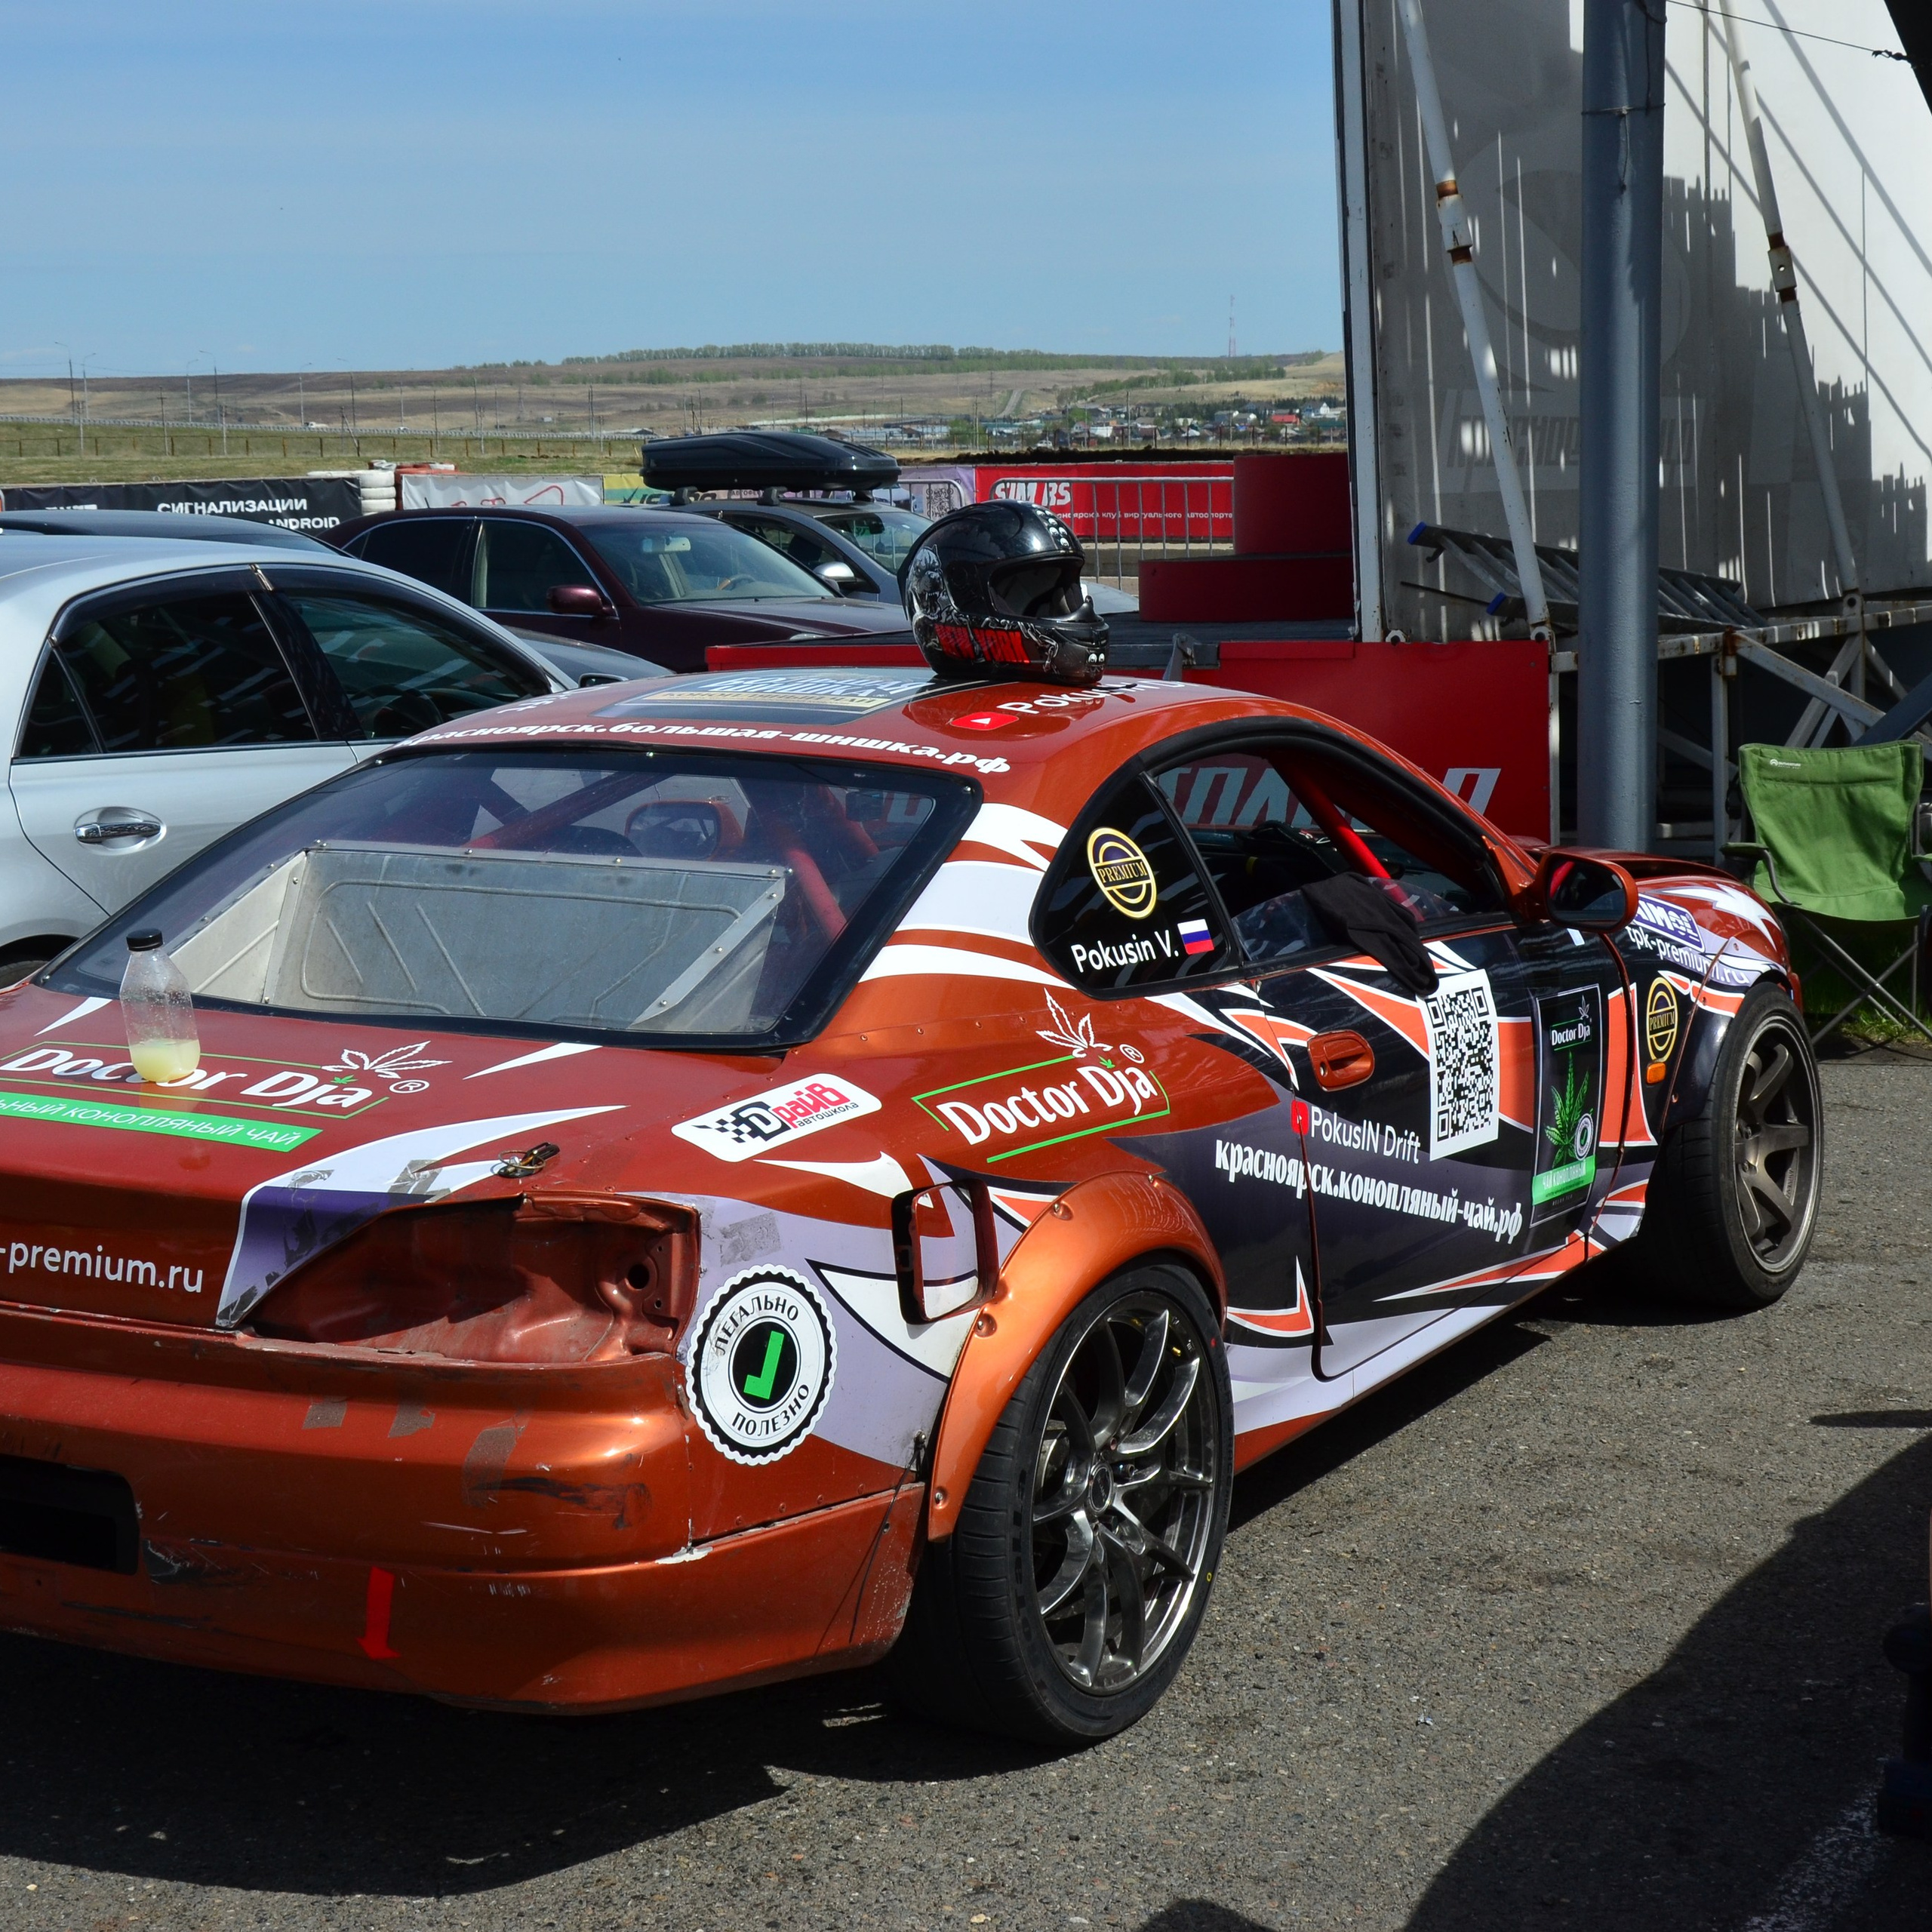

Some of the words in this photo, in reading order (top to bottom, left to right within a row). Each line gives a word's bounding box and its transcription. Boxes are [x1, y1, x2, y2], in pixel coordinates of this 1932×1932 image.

[157, 498, 307, 515] СИГНАЛИЗАЦИИ
[974, 628, 1031, 663] YORK
[1097, 862, 1148, 884] PREMIUM
[1070, 934, 1156, 974] Pokusin
[1154, 929, 1179, 958] V.
[1625, 926, 1751, 984] tpk-premium.ru
[1551, 1025, 1577, 1046] Doctor
[1649, 1011, 1675, 1032] PREMIUM
[240, 1070, 373, 1108] Dja
[937, 1078, 1081, 1145] Doctor
[1077, 1063, 1158, 1115] Dja
[61, 1107, 245, 1136] КОНОПЛЯНЫЙ
[245, 1128, 301, 1146] ЧАЙ
[796, 1103, 859, 1127] автошкола
[1311, 1106, 1380, 1154] PokusIN
[1383, 1124, 1421, 1164] Drift
[1215, 1139, 1523, 1244] красноярск.конопляный-чай.рф
[715, 1294, 799, 1355] ЛЕГАЛЬНО
[731, 1383, 811, 1437] ПОЛЕЗНО
